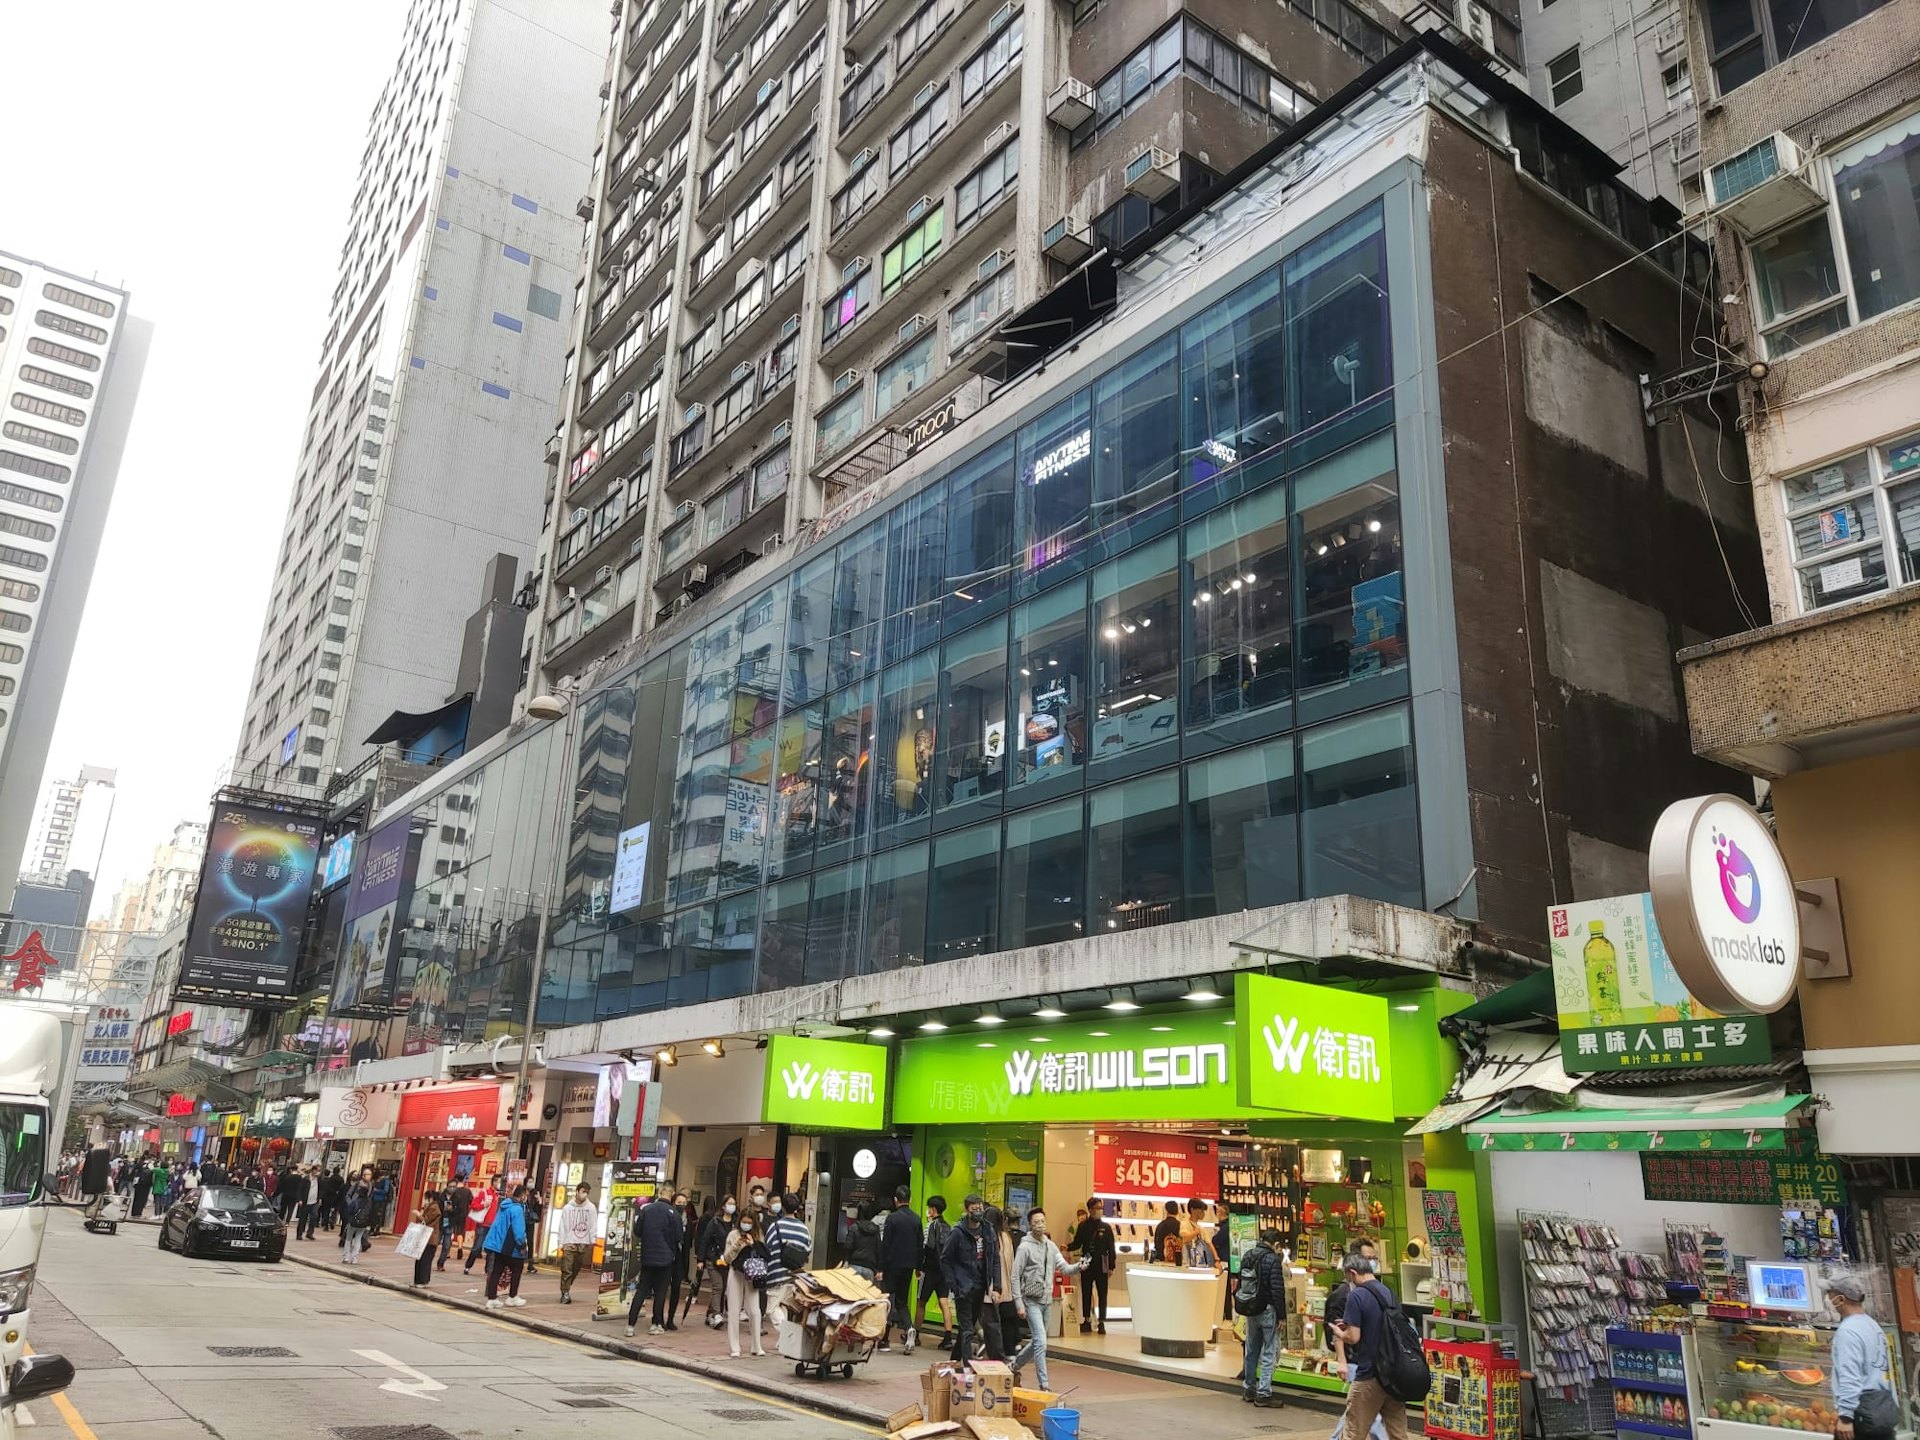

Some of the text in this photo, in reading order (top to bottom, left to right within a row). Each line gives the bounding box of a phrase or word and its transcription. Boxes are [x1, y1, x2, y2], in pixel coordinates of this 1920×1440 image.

[1035, 430, 1091, 474] ANYTIME
[1035, 445, 1091, 485] FITNESS
[217, 857, 304, 883] 漫遊專家
[0, 930, 59, 991] 食
[1711, 933, 1785, 965] masklab
[94, 1023, 129, 1038] 女人世界
[1577, 1022, 1748, 1055] 果味人間士多
[1039, 1052, 1092, 1092] 衛訊
[1091, 1043, 1228, 1089] WILSON
[1312, 1025, 1380, 1084] 衛訊
[821, 1067, 875, 1104] 衛訊
